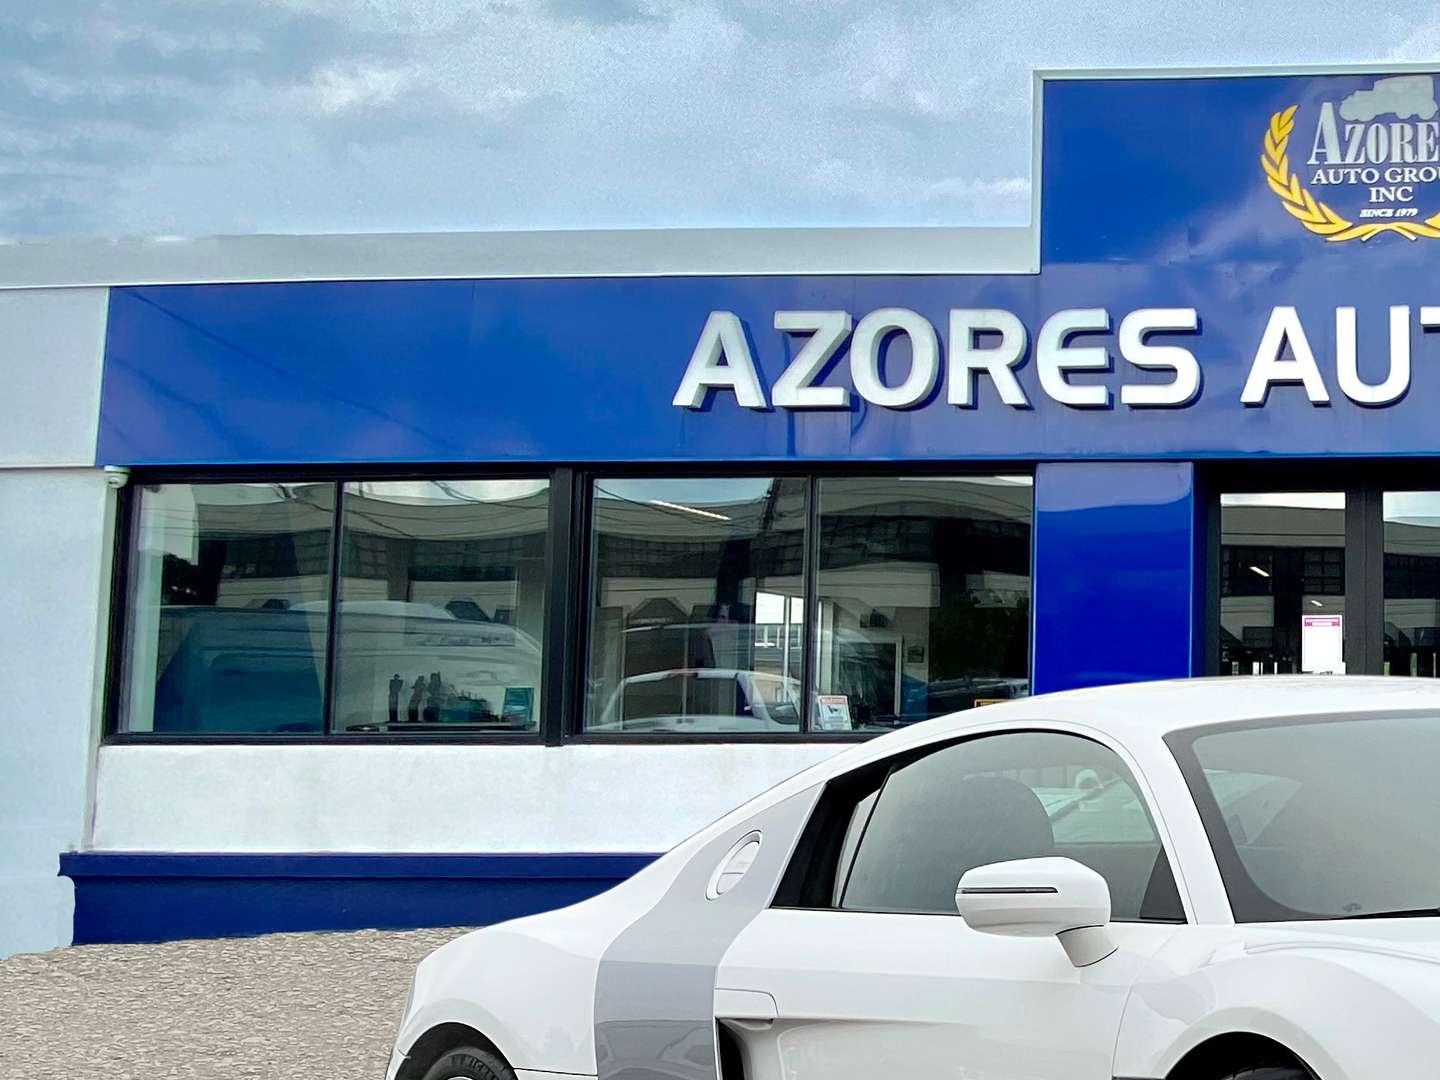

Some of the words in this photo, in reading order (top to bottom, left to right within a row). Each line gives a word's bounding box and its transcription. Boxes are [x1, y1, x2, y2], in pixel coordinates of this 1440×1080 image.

[1311, 167, 1380, 185] AUTO
[1369, 186, 1414, 203] INC
[1360, 208, 1393, 218] SINCE
[1395, 207, 1418, 217] 1979
[672, 308, 1202, 412] AZORES
